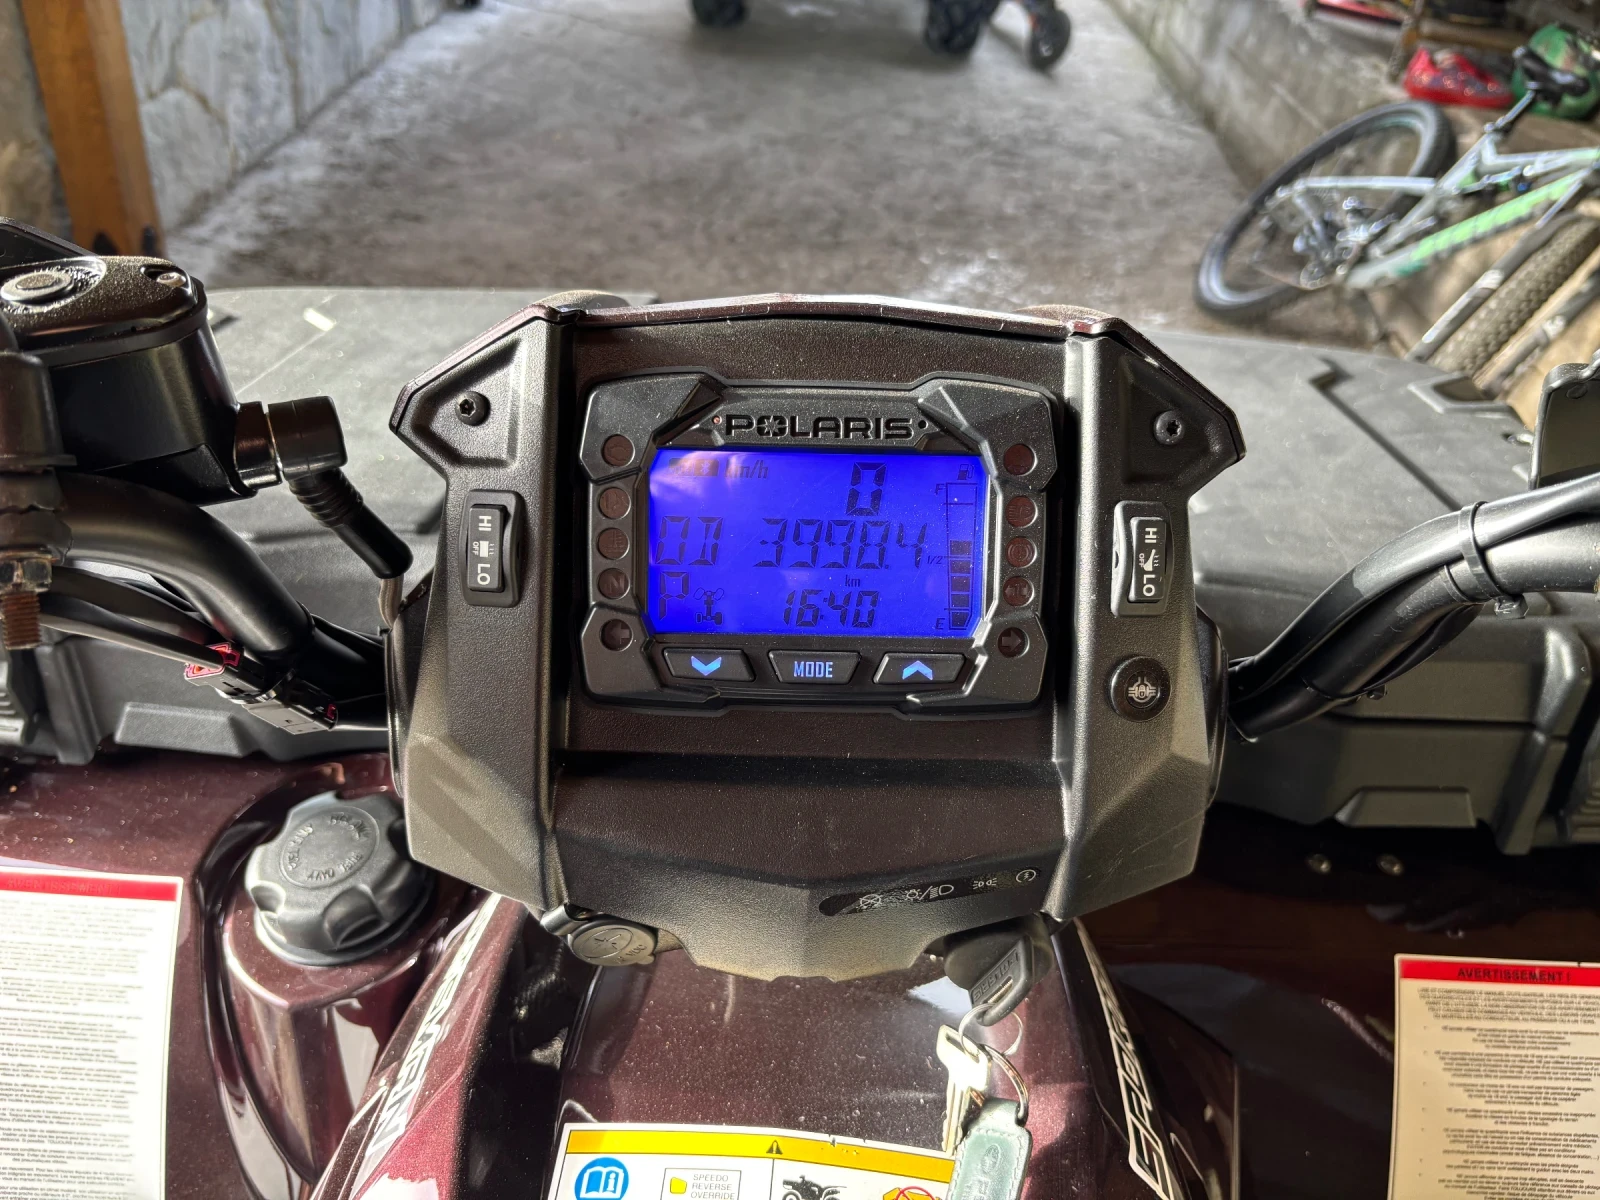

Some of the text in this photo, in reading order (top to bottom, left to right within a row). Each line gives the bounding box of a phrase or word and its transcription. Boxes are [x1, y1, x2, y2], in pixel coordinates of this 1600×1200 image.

[725, 413, 914, 439] POLARIS
[725, 459, 887, 516] km/h 0
[478, 515, 492, 532] HI
[1144, 527, 1158, 543] HI
[472, 541, 480, 556] OFF
[926, 554, 943, 565] 1/2
[477, 563, 491, 585] LO
[844, 574, 861, 588] km
[1142, 574, 1156, 597] LO
[658, 571, 880, 628] P 16:40
[935, 617, 946, 631] E
[793, 661, 833, 679] MODE
[1457, 967, 1564, 982] AVERTISSEMENT
[693, 1174, 729, 1182] SPEEDO
[691, 1182, 732, 1191] REVERSE
[690, 1191, 736, 1200] OVERRIDE
